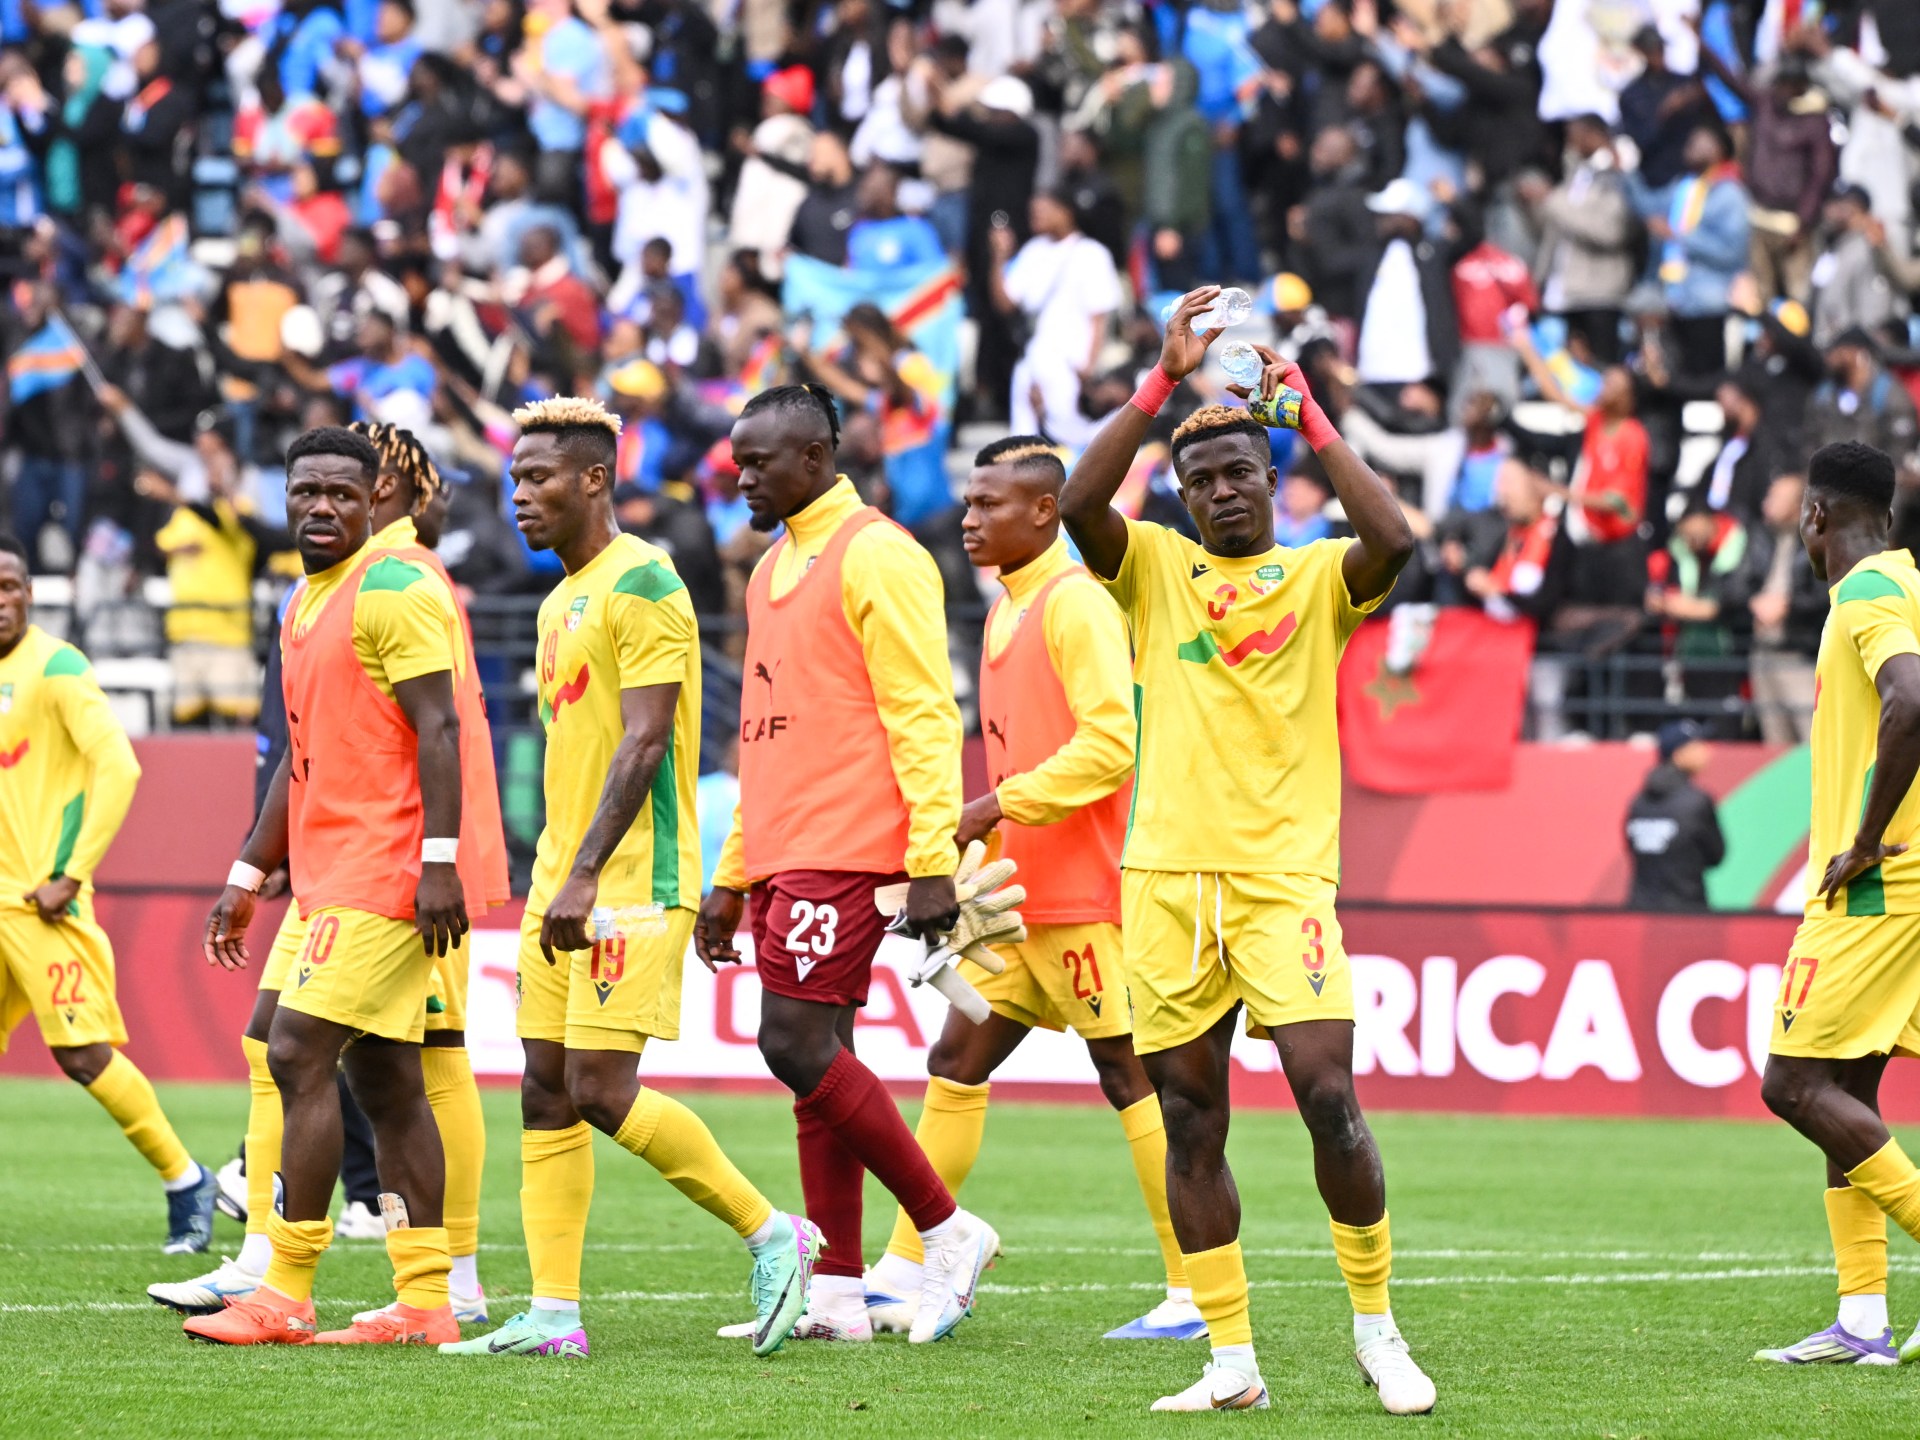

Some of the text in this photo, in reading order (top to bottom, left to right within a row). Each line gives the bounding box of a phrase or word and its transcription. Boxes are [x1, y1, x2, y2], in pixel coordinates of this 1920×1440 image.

[1207, 583, 1238, 621] 3
[541, 629, 559, 685] 19
[742, 715, 787, 743] CAF
[302, 912, 340, 965] 10
[785, 899, 839, 956] 23
[1301, 917, 1325, 971] 3
[47, 960, 86, 1006] 22
[590, 931, 626, 983] 19
[1062, 942, 1104, 1000] 21
[1782, 957, 1819, 1009] 17
[1231, 954, 1642, 1082] RICA
